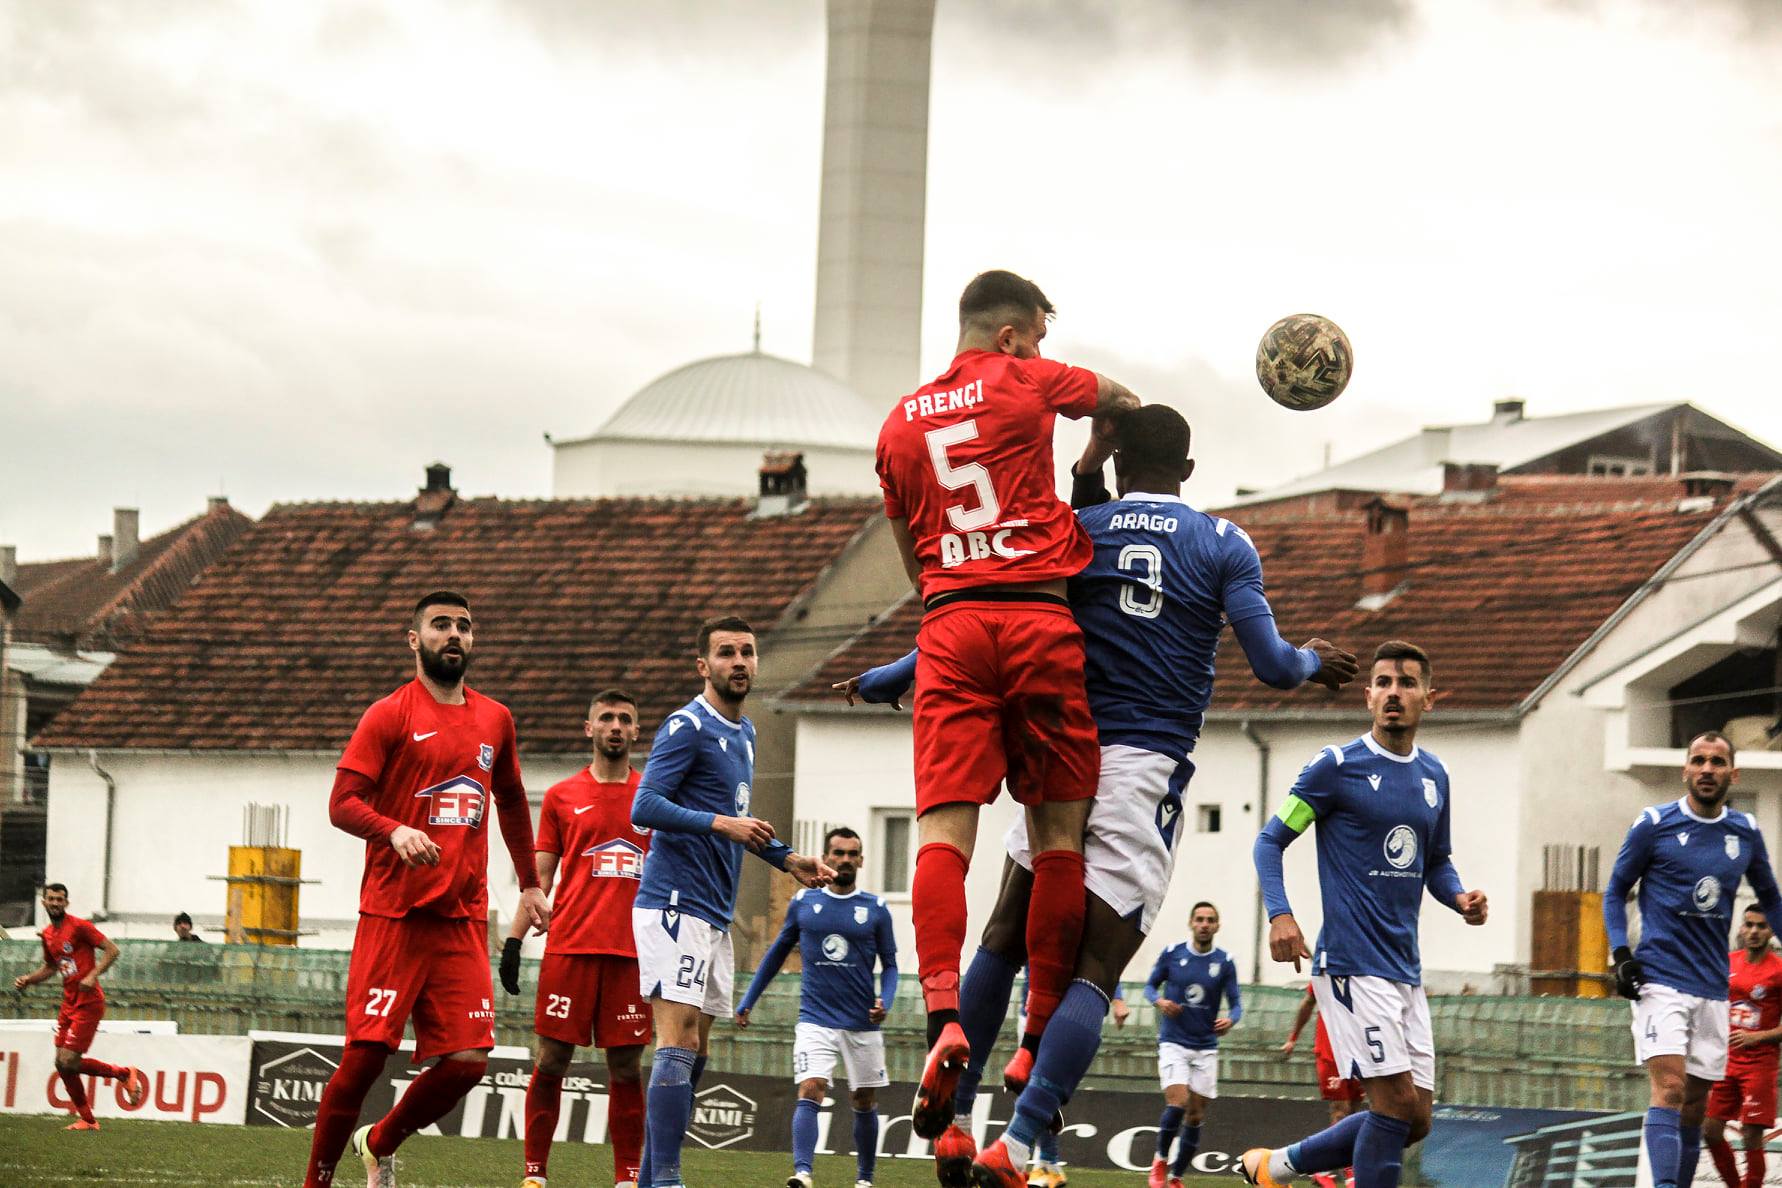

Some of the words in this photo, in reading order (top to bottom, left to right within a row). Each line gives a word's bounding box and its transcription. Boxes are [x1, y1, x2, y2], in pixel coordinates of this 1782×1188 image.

[904, 380, 984, 422] PRENÇI
[925, 419, 1000, 532] 5
[1109, 513, 1178, 533] ARAGO
[940, 529, 1017, 564] ABC
[1118, 544, 1164, 619] 3
[594, 850, 636, 872] FF
[676, 954, 706, 993] 24
[364, 987, 398, 1017] 27
[545, 993, 572, 1019] 23
[1365, 1026, 1385, 1064] 5
[272, 1078, 326, 1102] KIM
[694, 1107, 743, 1127] KIMI
